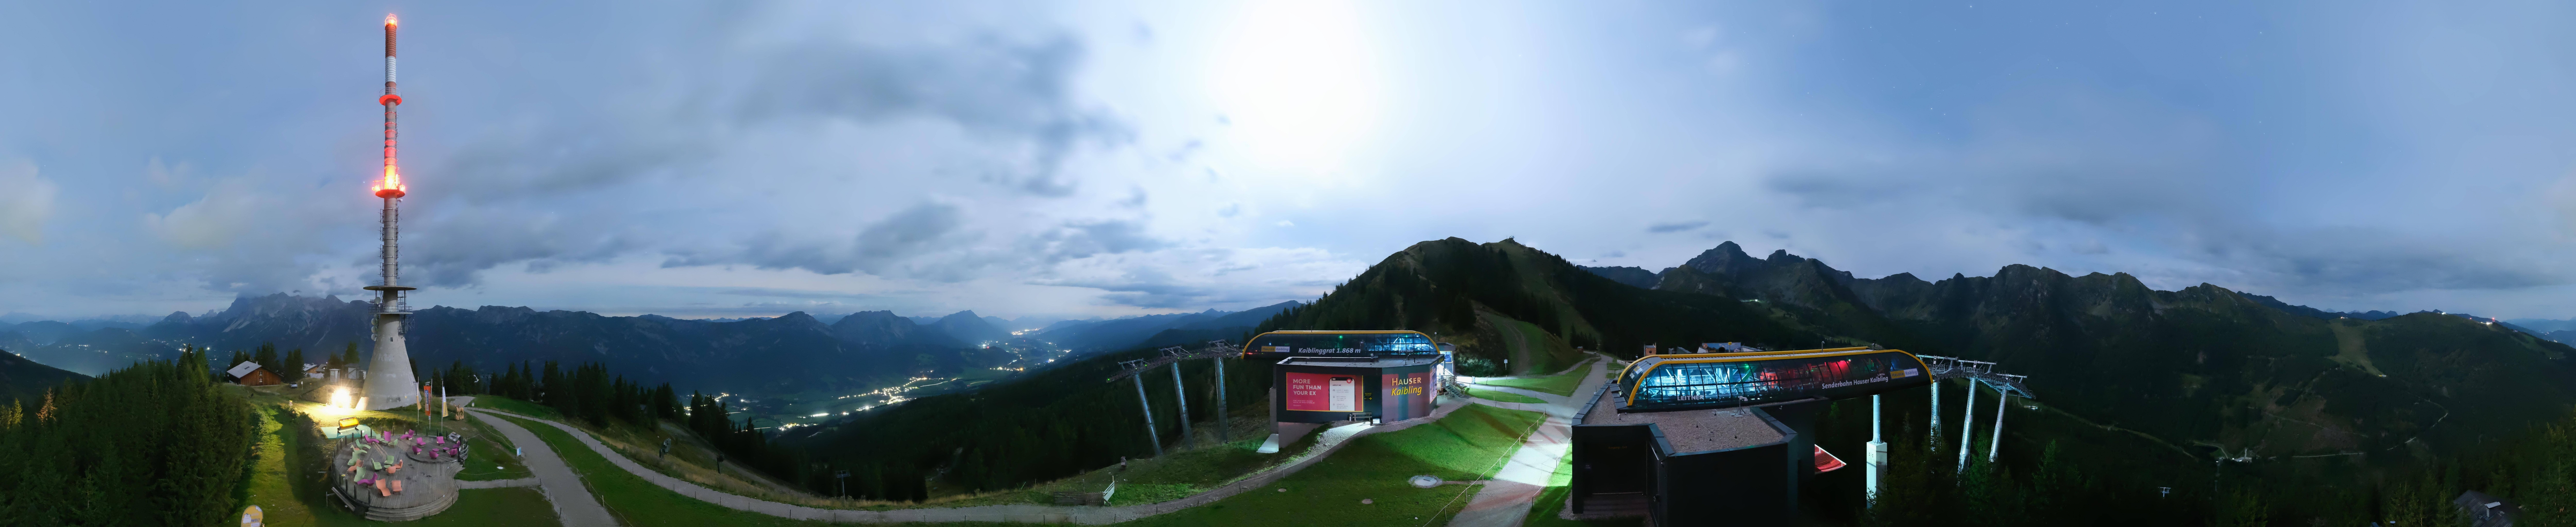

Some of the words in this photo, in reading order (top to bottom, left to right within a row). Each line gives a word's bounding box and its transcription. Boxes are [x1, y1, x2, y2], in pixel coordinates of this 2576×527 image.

[1392, 377, 1421, 386] HAUSER
[1822, 380, 1852, 389] Senderbahn
[1391, 386, 1422, 396] Kaibling
